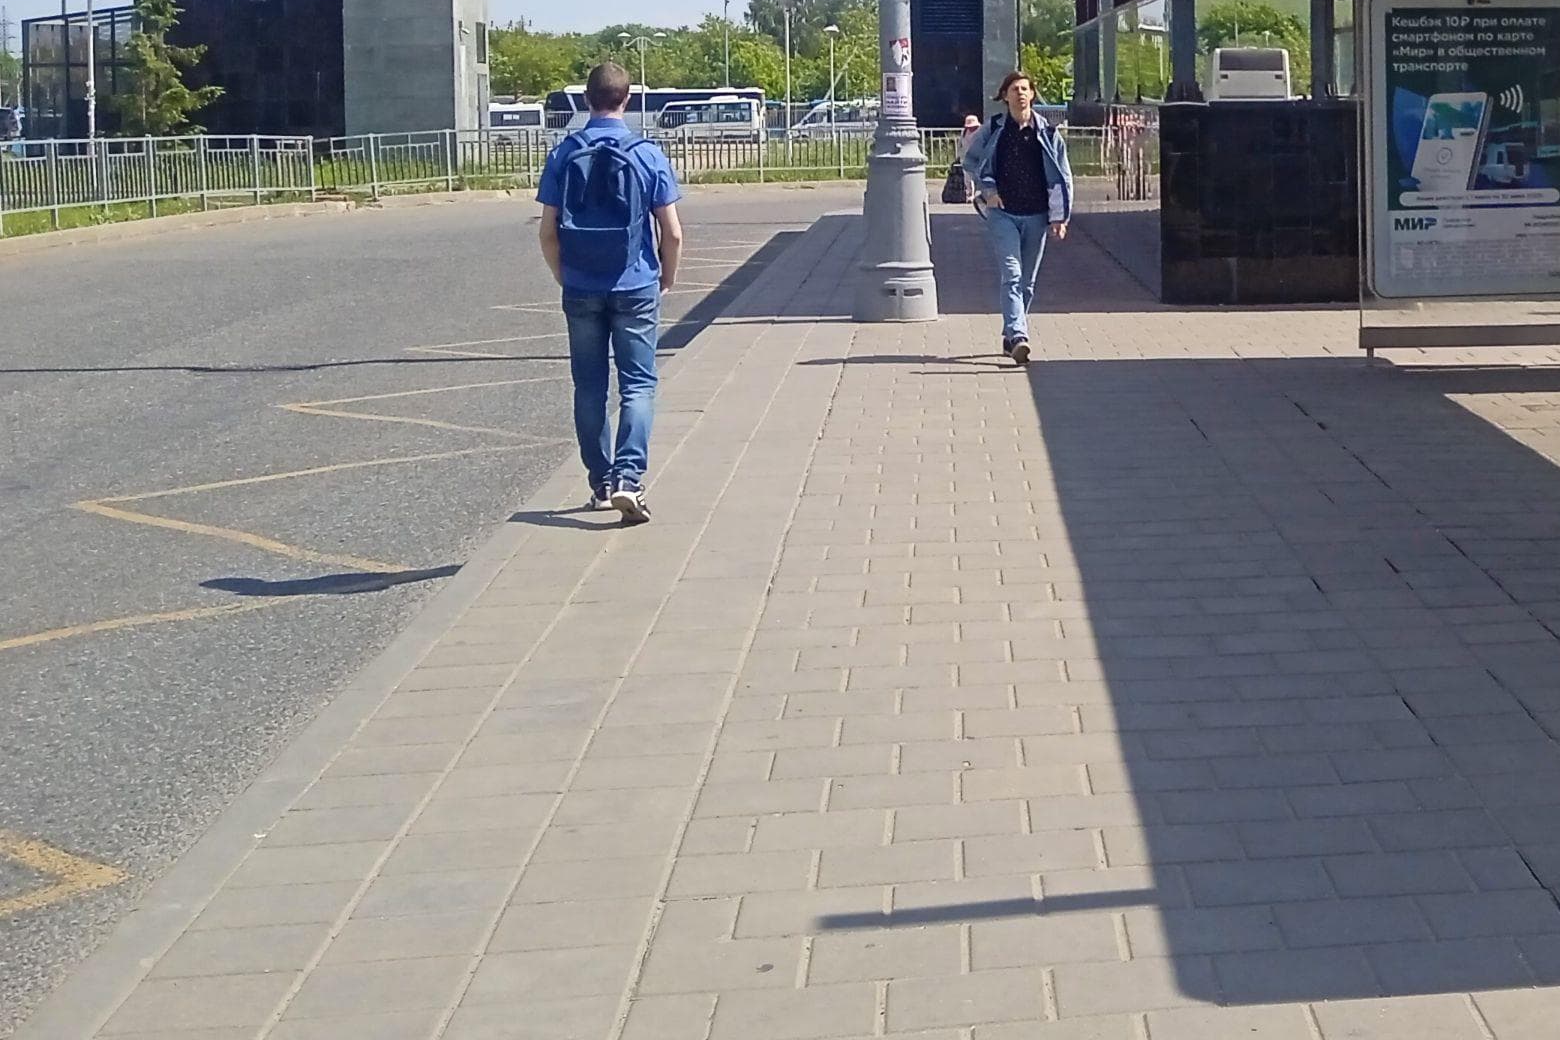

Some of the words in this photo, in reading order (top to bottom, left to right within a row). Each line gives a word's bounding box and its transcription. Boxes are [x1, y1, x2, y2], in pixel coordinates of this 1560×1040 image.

[1391, 16, 1442, 27] Кешбэк
[1473, 17, 1498, 28] при
[1501, 17, 1546, 27] оплате
[1391, 31, 1474, 43] смартфоном
[1477, 32, 1494, 41] по
[1497, 32, 1535, 43] карте
[1437, 47, 1445, 56] в
[1448, 46, 1546, 57] общественном
[1392, 62, 1469, 73] транспорте
[1394, 217, 1437, 231] МИР
